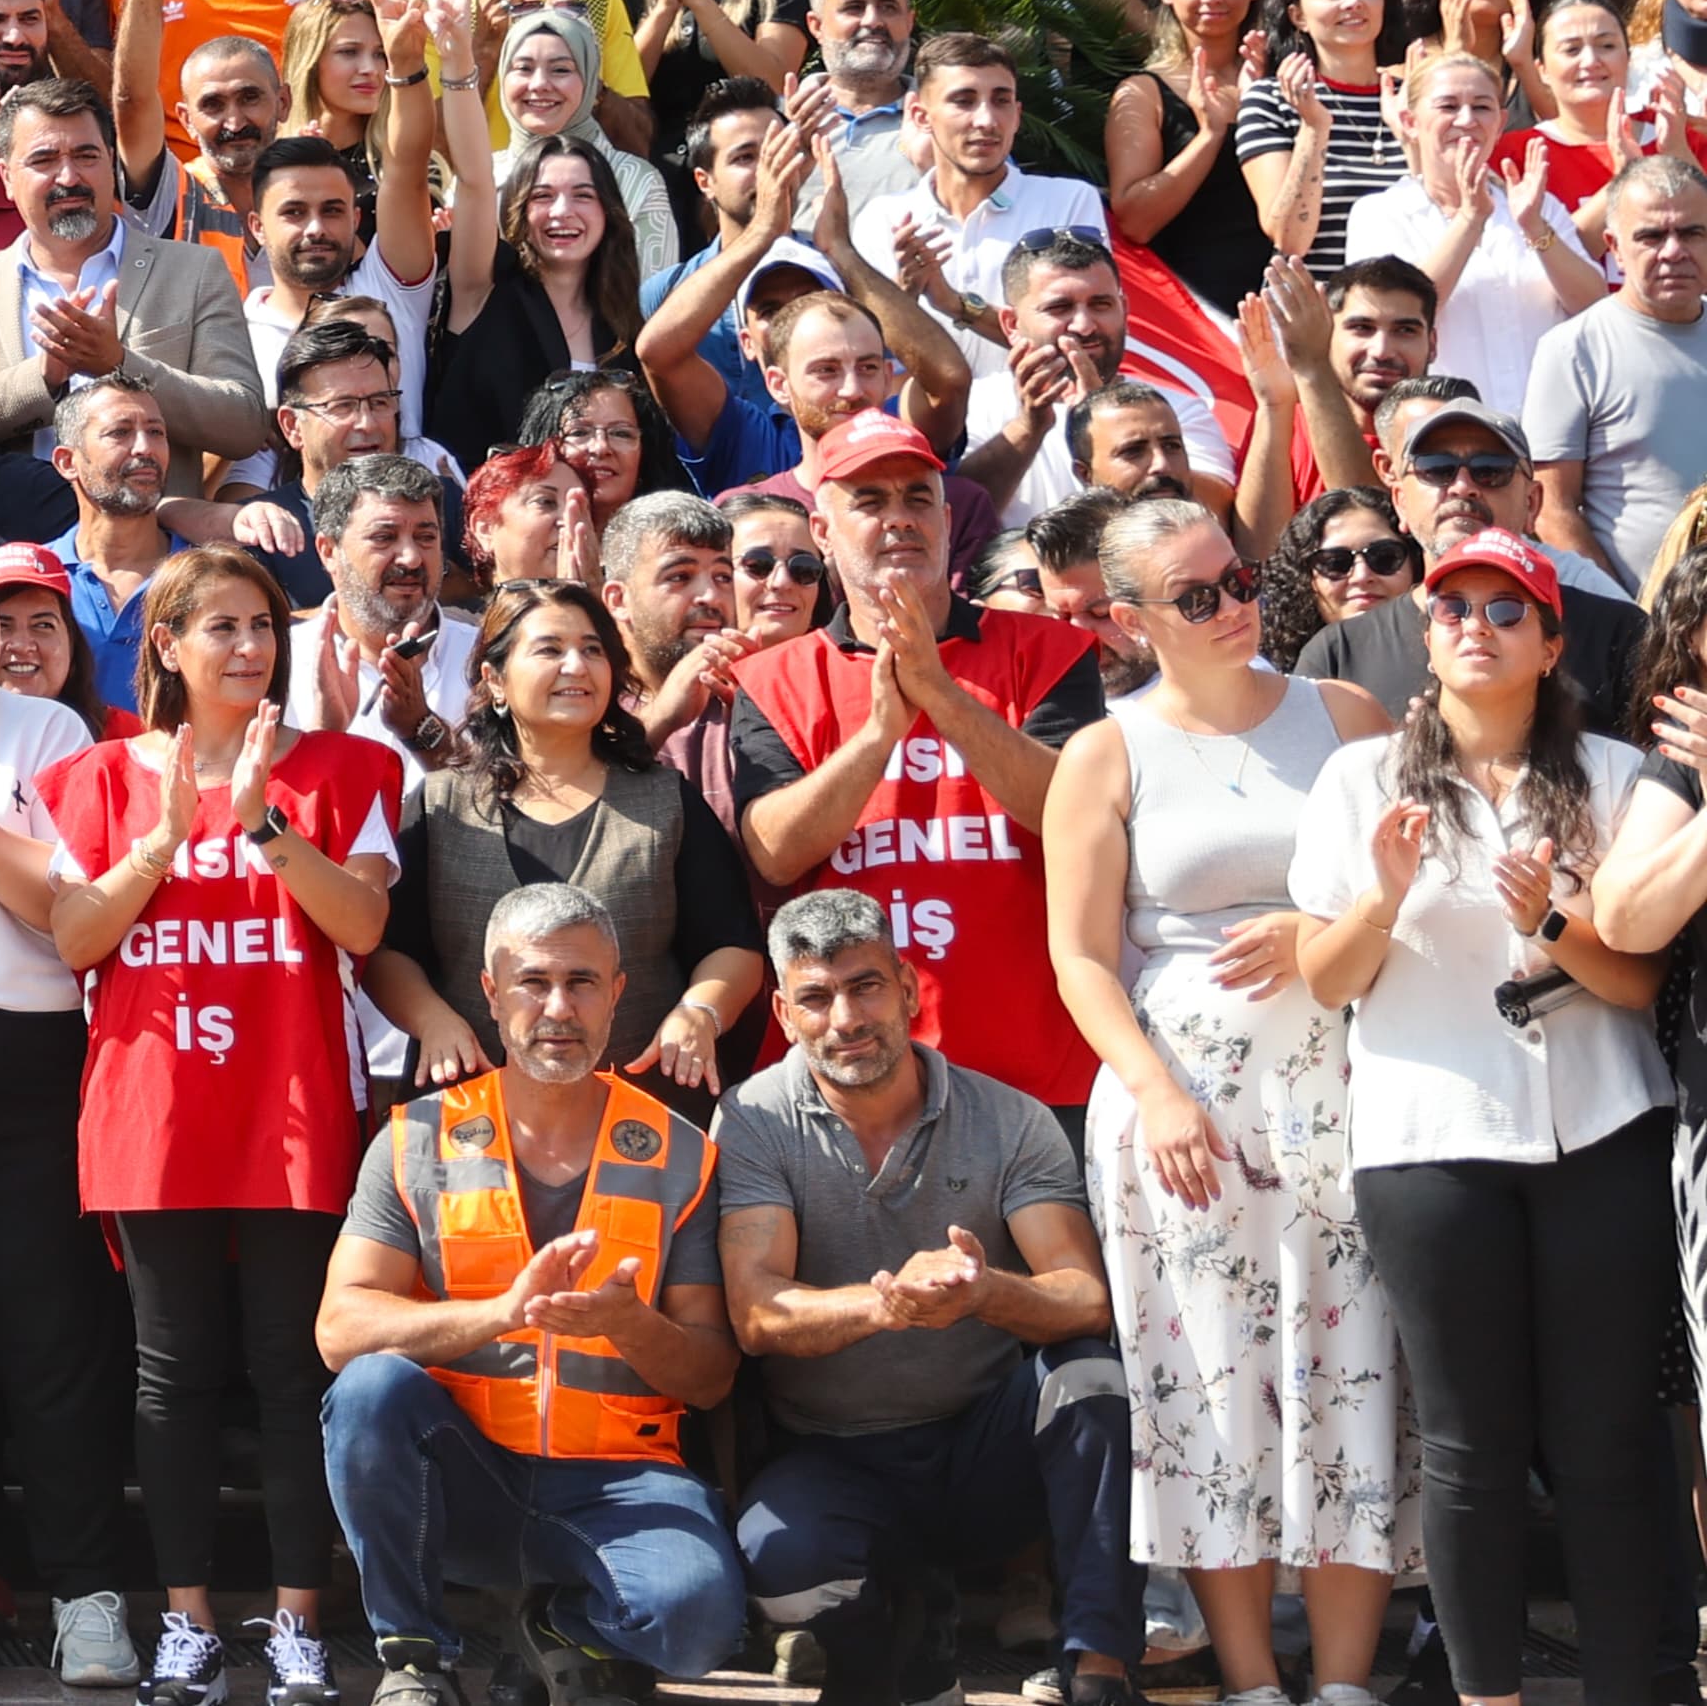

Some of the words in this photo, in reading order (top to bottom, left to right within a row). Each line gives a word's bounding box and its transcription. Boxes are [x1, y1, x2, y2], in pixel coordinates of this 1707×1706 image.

[830, 816, 1021, 874] GENEL
[120, 918, 303, 967] GENEL
[890, 889, 955, 960] İŞ
[174, 993, 235, 1065] İŞ
